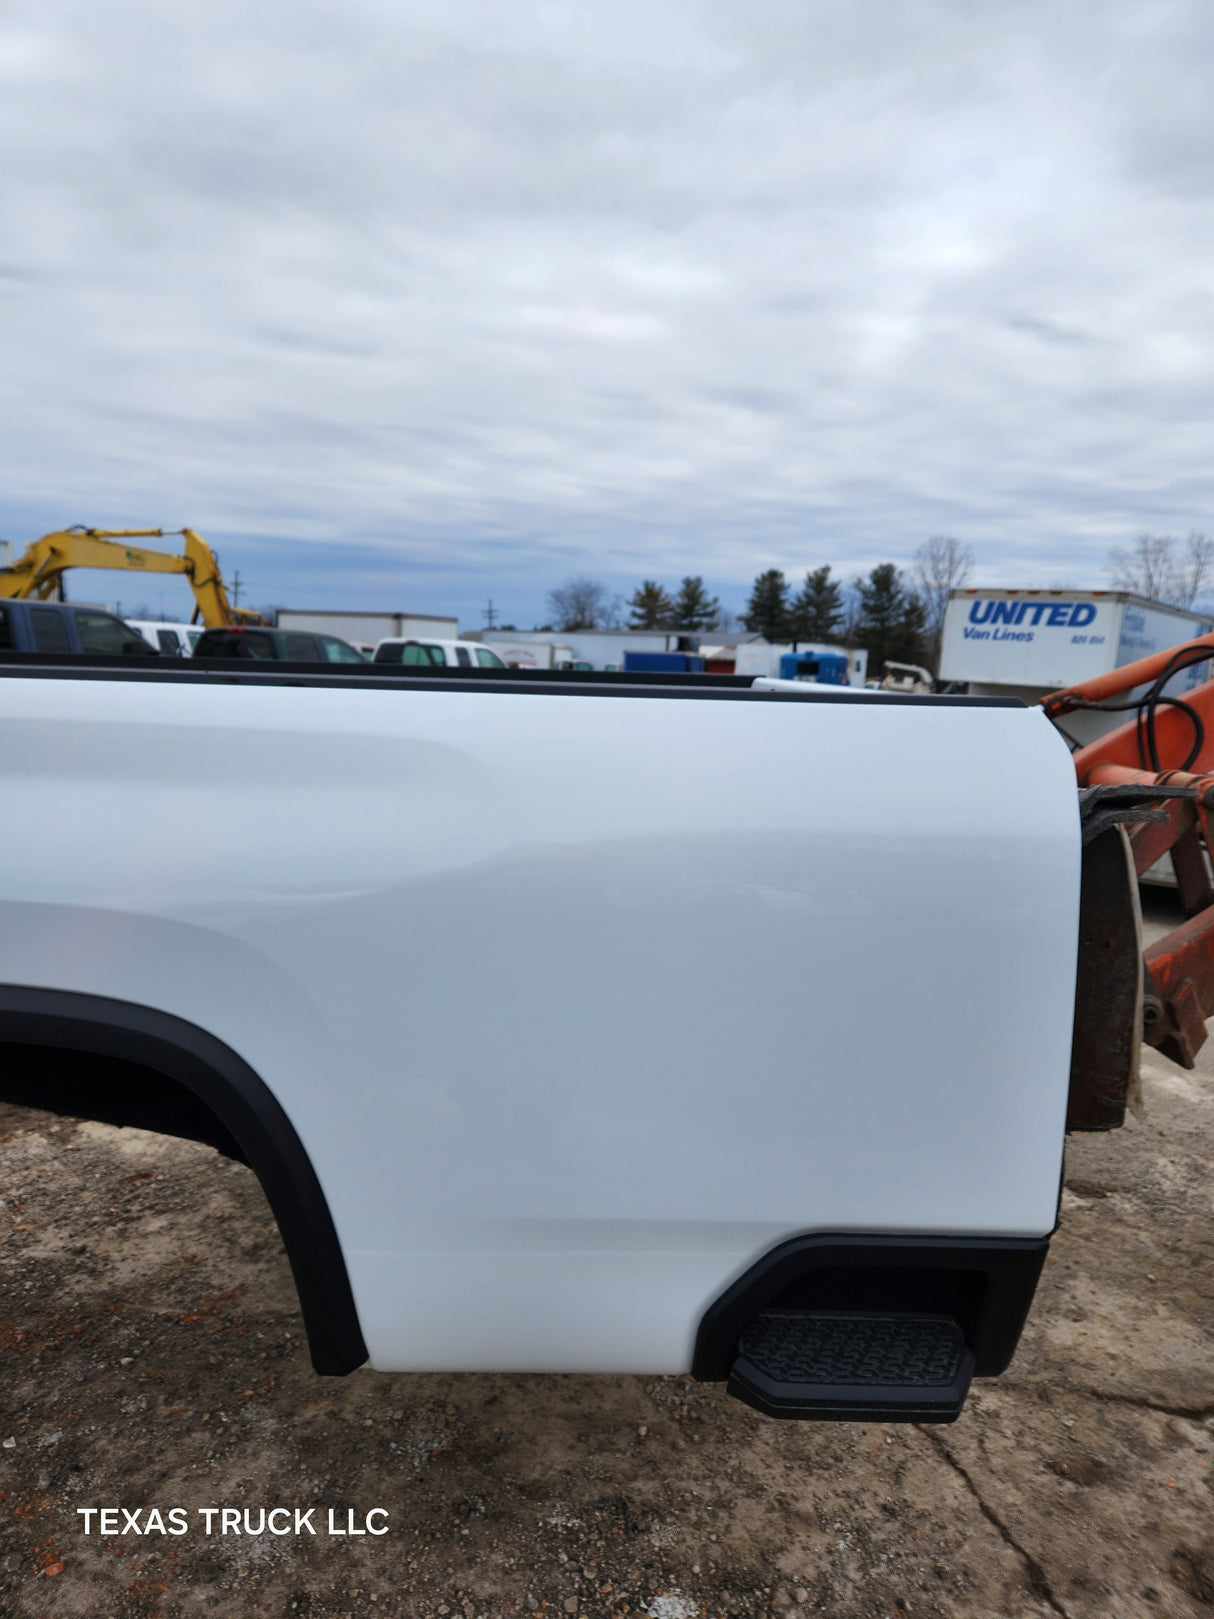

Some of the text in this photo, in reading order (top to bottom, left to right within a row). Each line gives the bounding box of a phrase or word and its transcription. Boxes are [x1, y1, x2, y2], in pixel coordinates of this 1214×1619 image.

[969, 600, 1097, 627] UNITED
[963, 627, 1034, 641] Van Lines
